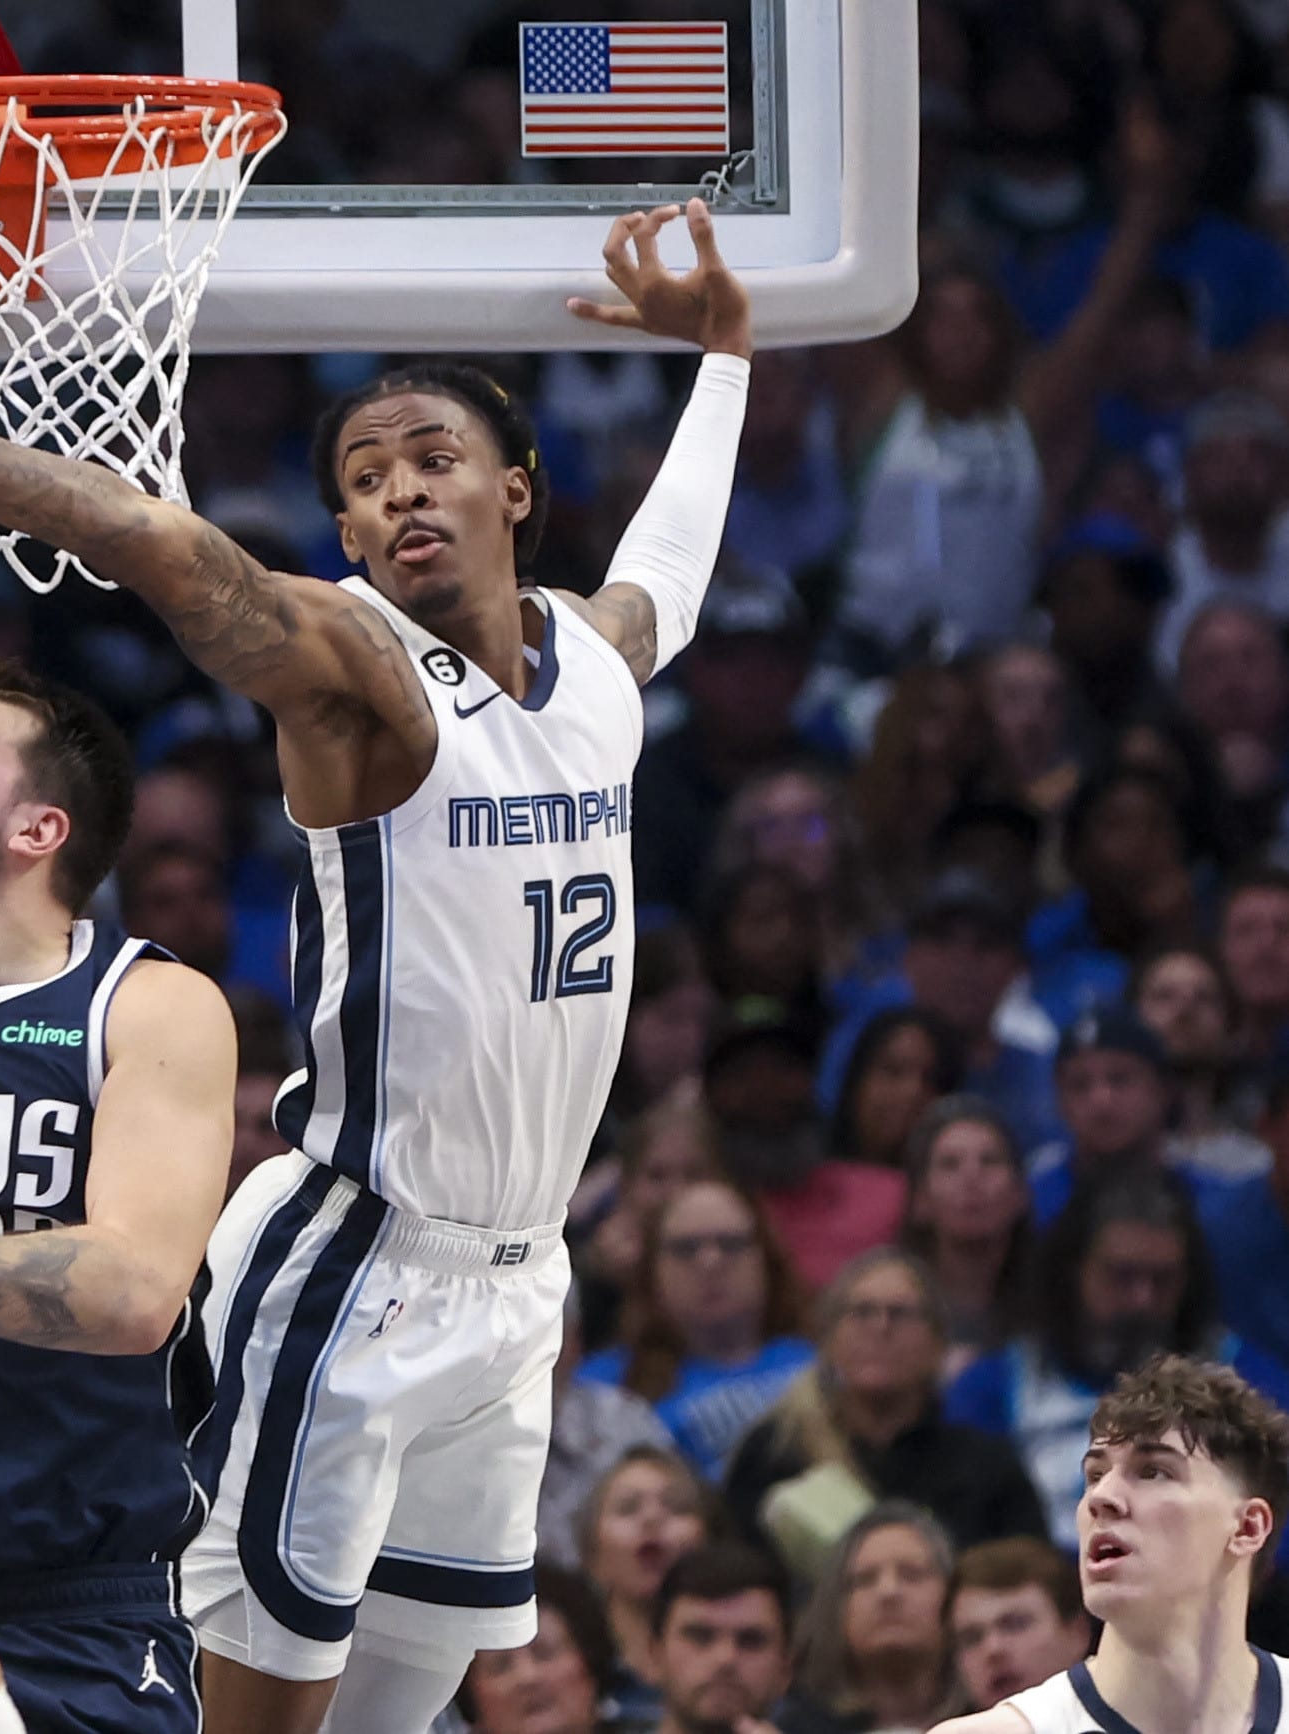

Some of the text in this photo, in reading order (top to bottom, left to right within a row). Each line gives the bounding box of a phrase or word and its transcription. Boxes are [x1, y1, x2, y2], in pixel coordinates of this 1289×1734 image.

[426, 652, 460, 684] 6
[448, 783, 634, 848] MEMPHI
[523, 872, 617, 1003] 12
[0, 1020, 85, 1047] chime
